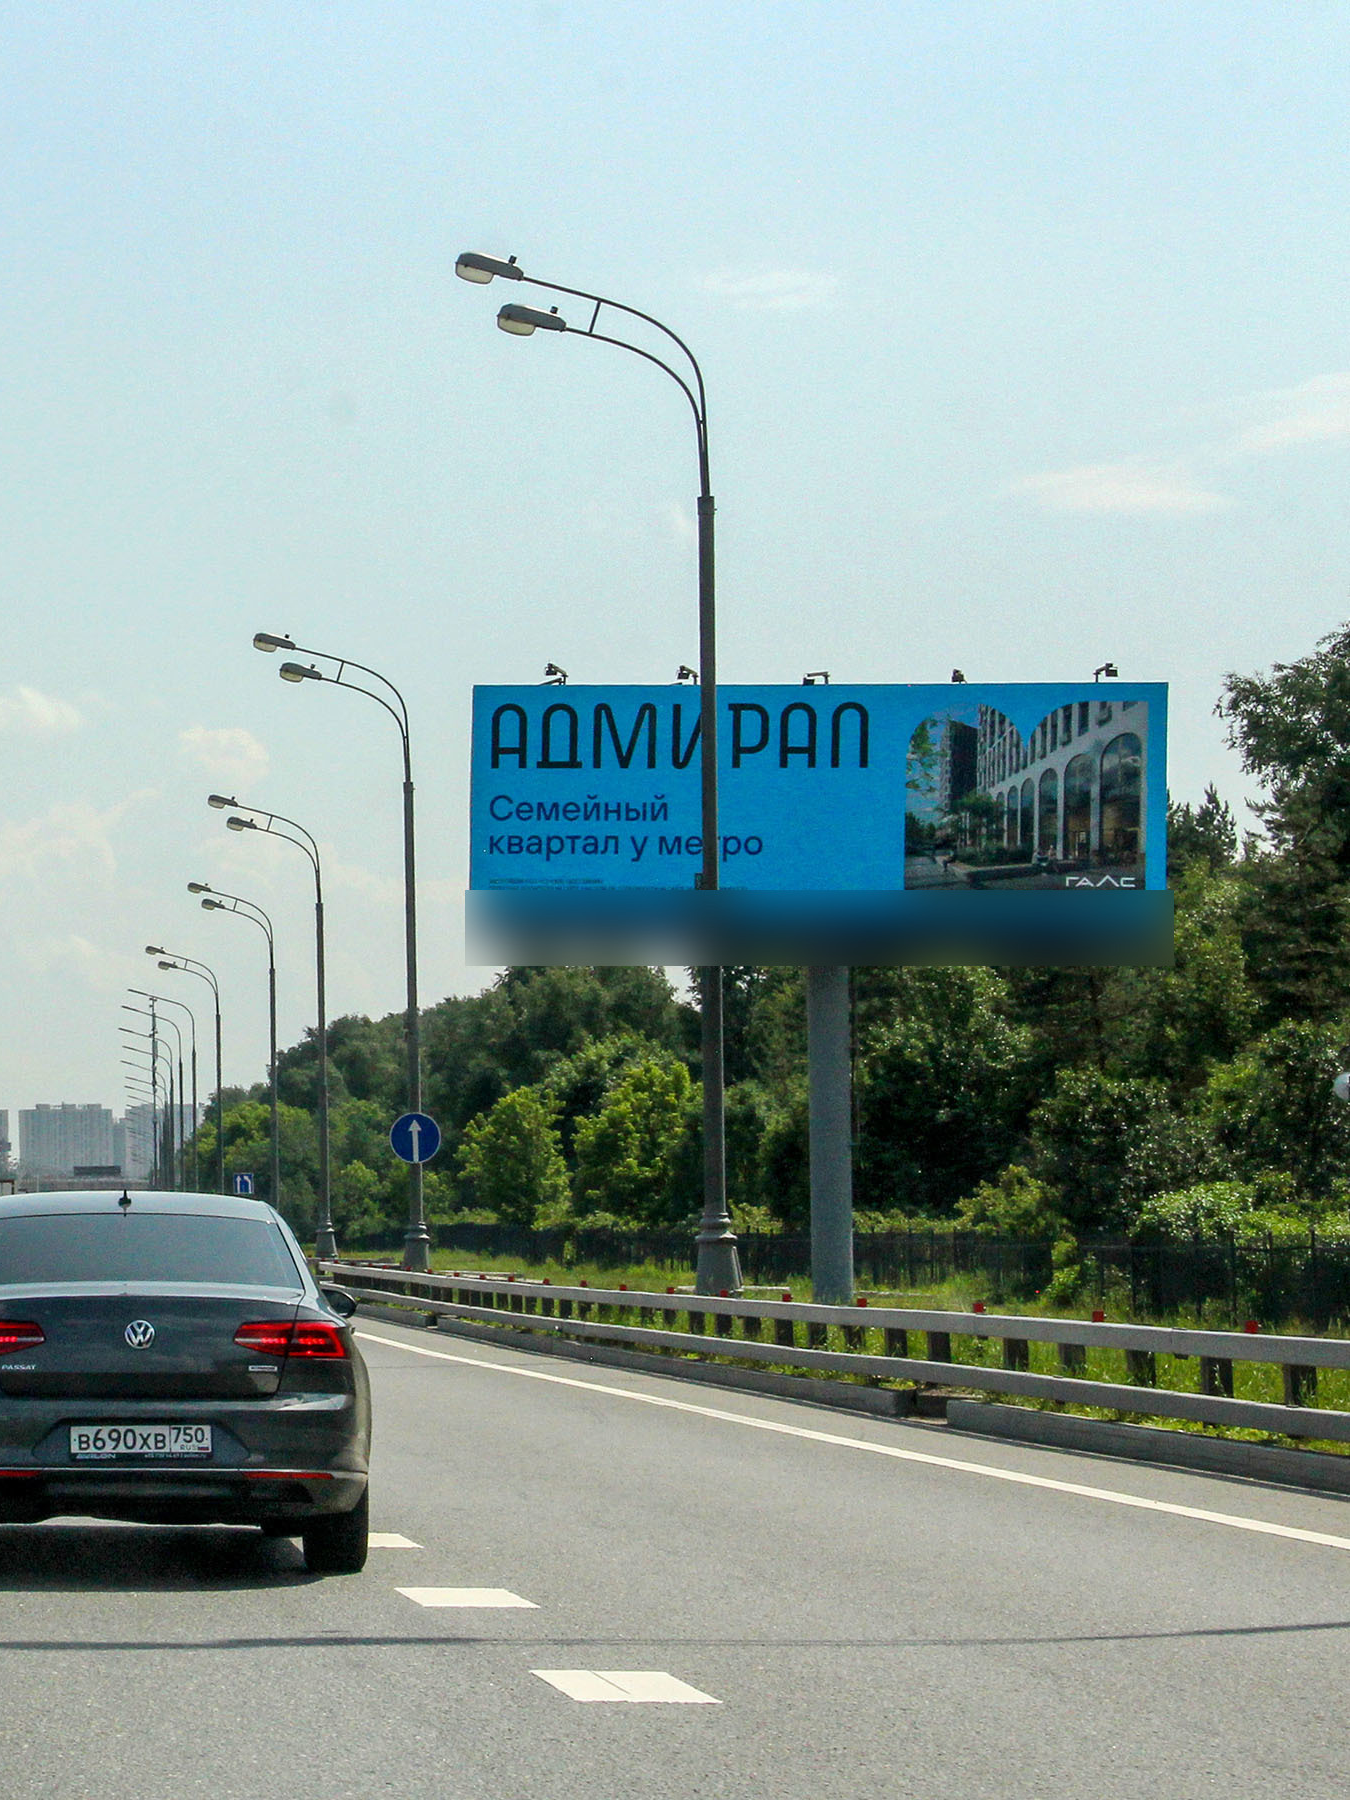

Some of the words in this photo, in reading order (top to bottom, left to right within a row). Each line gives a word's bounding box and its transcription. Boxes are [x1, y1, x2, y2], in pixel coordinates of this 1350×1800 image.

[490, 702, 869, 769] АДМИРАЛ
[489, 794, 669, 822] Семейный
[488, 834, 620, 862] квартал
[630, 835, 648, 862] у
[658, 835, 763, 862] меро
[1065, 874, 1136, 888] ГАЛС
[171, 1426, 205, 1443] 750
